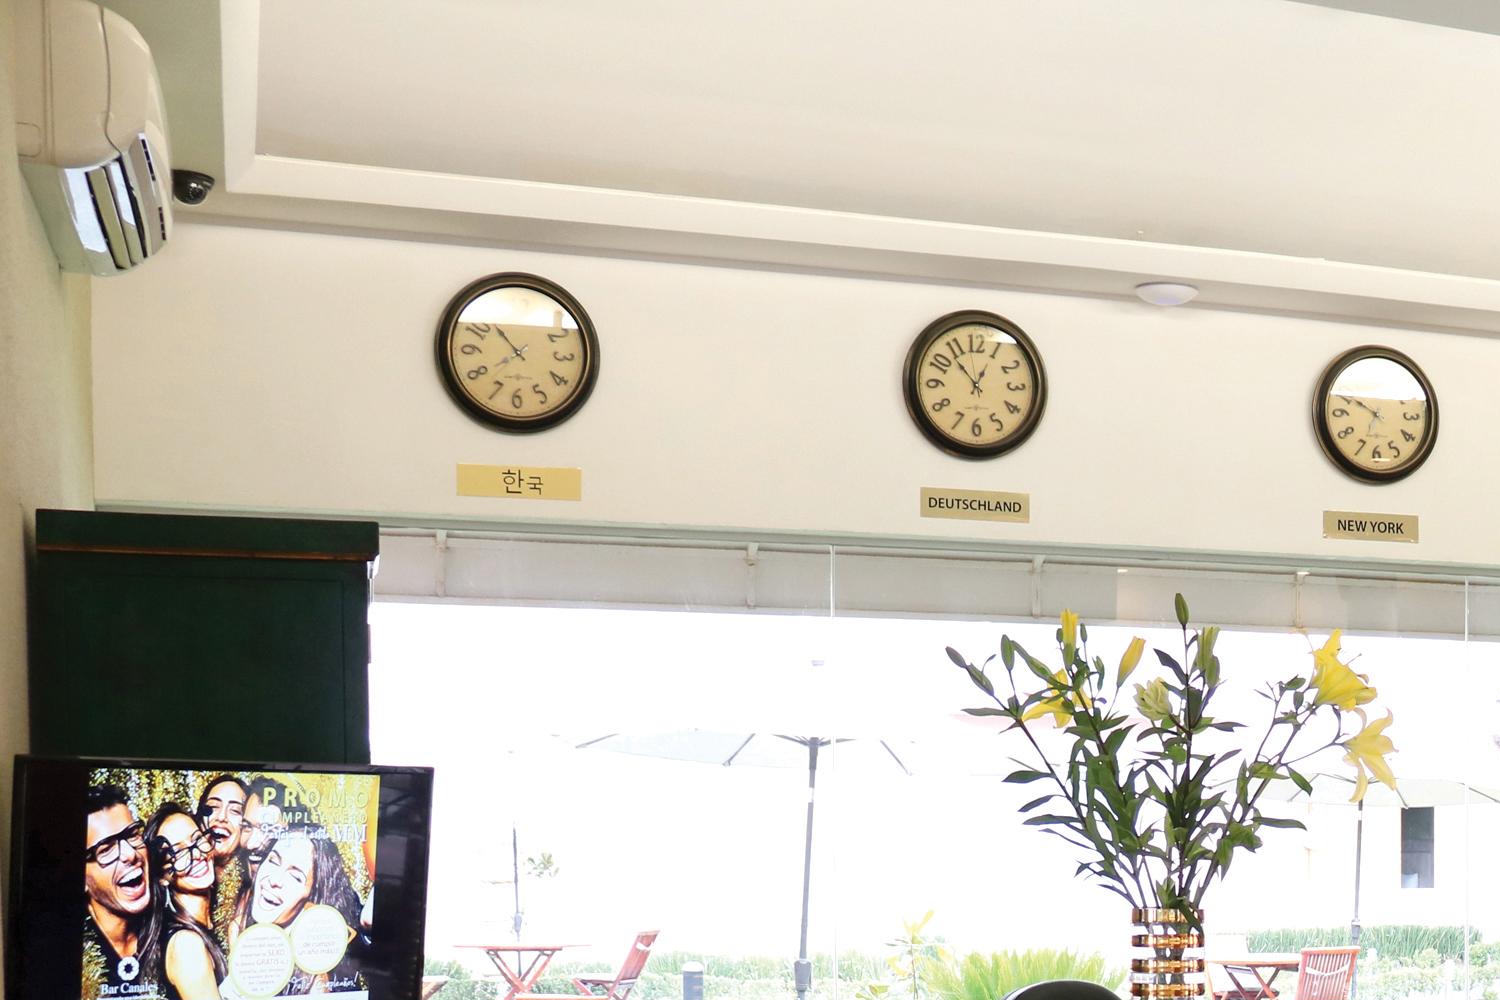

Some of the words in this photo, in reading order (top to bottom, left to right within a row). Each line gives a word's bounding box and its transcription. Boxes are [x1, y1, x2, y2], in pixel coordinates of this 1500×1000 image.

[461, 344, 483, 355] 9
[945, 337, 967, 360] 11
[967, 334, 986, 354] 12
[989, 342, 1001, 360] 1
[553, 350, 575, 362] 3
[929, 352, 952, 375] 10
[467, 365, 489, 381] 8
[1001, 359, 1020, 375] 2
[549, 370, 569, 387] 4
[926, 377, 946, 389] 9
[1007, 381, 1026, 392] 3
[488, 381, 504, 400] 7
[511, 388, 524, 409] 6
[532, 384, 548, 405] 5
[931, 397, 951, 413] 8
[1003, 399, 1021, 415] 4
[1332, 407, 1350, 418] 9
[951, 411, 965, 430] 7
[989, 412, 1004, 433] 5
[1403, 412, 1420, 422] 3
[971, 417, 982, 437] 6
[1337, 426, 1355, 440] 8
[1400, 428, 1416, 443] 4
[1354, 438, 1367, 456] 7
[1371, 444, 1382, 463] 6
[1387, 440, 1400, 458] 5
[501, 468, 544, 496] 한국
[927, 496, 1023, 514] DEUTSCHLAND
[1336, 519, 1368, 533] NEW
[1370, 521, 1404, 535] YORK
[262, 786, 370, 809] PROMO
[101, 983, 119, 995] Bar
[120, 980, 159, 994] Canales
